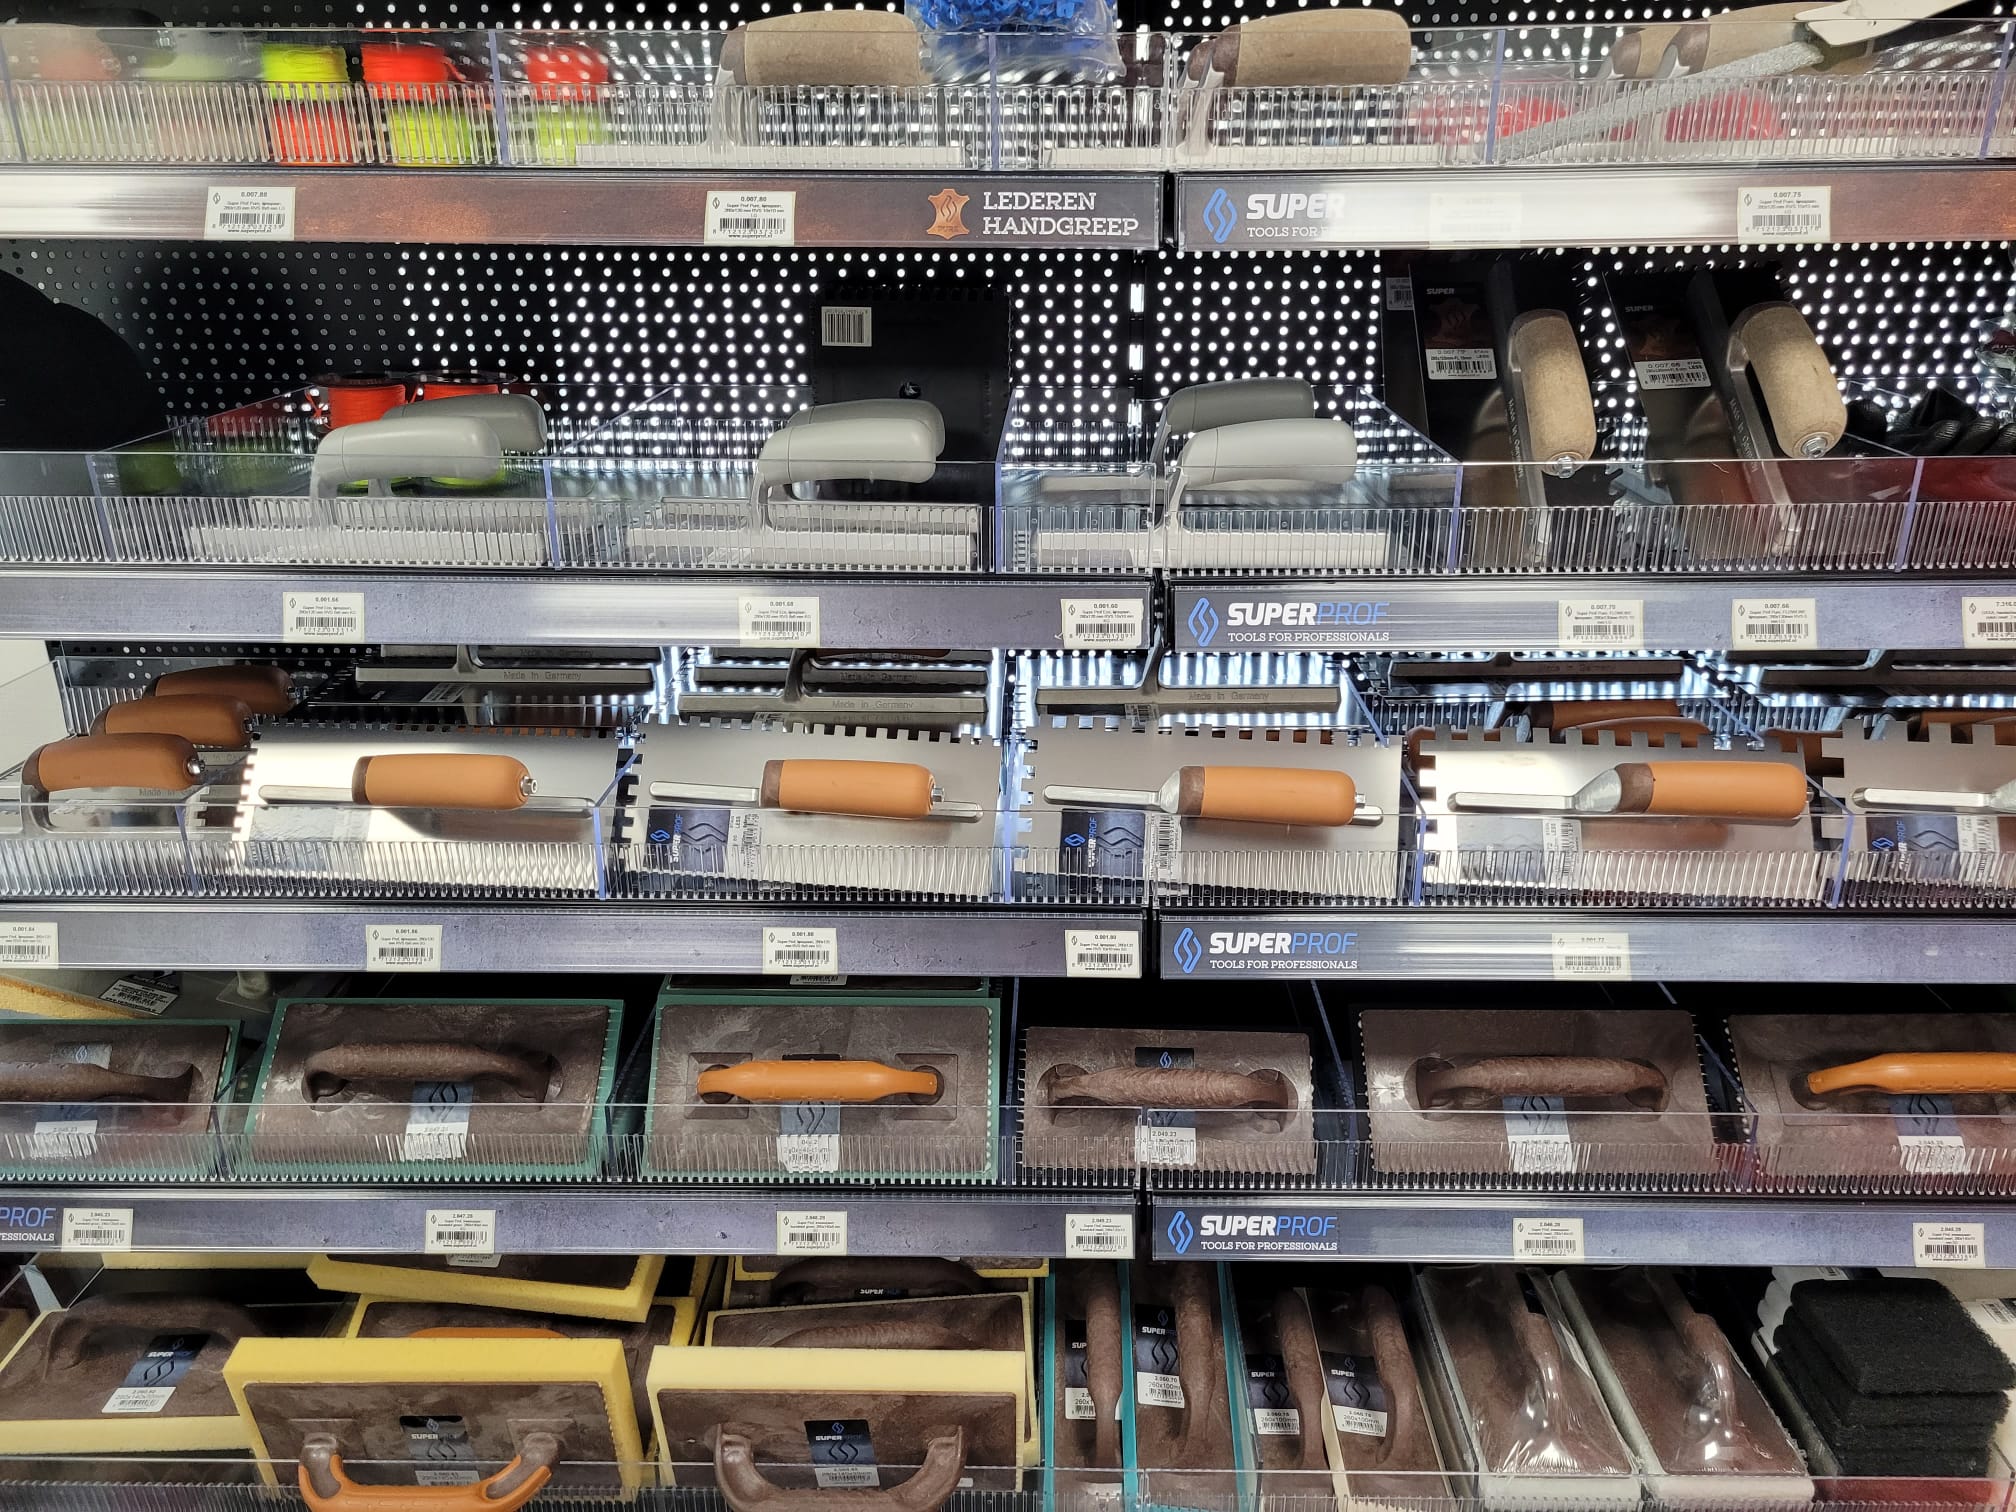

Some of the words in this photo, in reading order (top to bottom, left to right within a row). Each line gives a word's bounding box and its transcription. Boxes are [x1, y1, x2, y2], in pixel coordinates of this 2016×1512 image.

[983, 192, 1096, 211] LEDEREN
[982, 217, 1139, 237] HANDGREEP
[1247, 226, 1289, 237] TOOLS
[1292, 226, 1317, 237] FOR
[1227, 602, 1390, 627] SUPERPROF
[1228, 632, 1266, 643] TOOLS
[1268, 632, 1293, 643] FOR
[1295, 632, 1390, 643] PROFESSIONALS
[504, 671, 525, 680] Made
[532, 671, 539, 680] in
[545, 671, 582, 682] Germany
[1190, 692, 1212, 700] Made
[1218, 692, 1226, 700] in
[1232, 692, 1269, 703] Germany
[833, 700, 855, 709] Made
[861, 700, 868, 709] in
[875, 700, 914, 711] Germany
[1209, 932, 1358, 954] SUPERPROF
[1210, 959, 1245, 969] TOOLS
[1247, 959, 1269, 969] FOR
[1271, 959, 1358, 969] PROFESSIONALS
[1200, 1215, 1338, 1236] SUPERPROF
[1201, 1241, 1233, 1251] TOOLS
[1235, 1241, 1256, 1251] FOR
[1257, 1241, 1338, 1251] PROFESSIONALS
